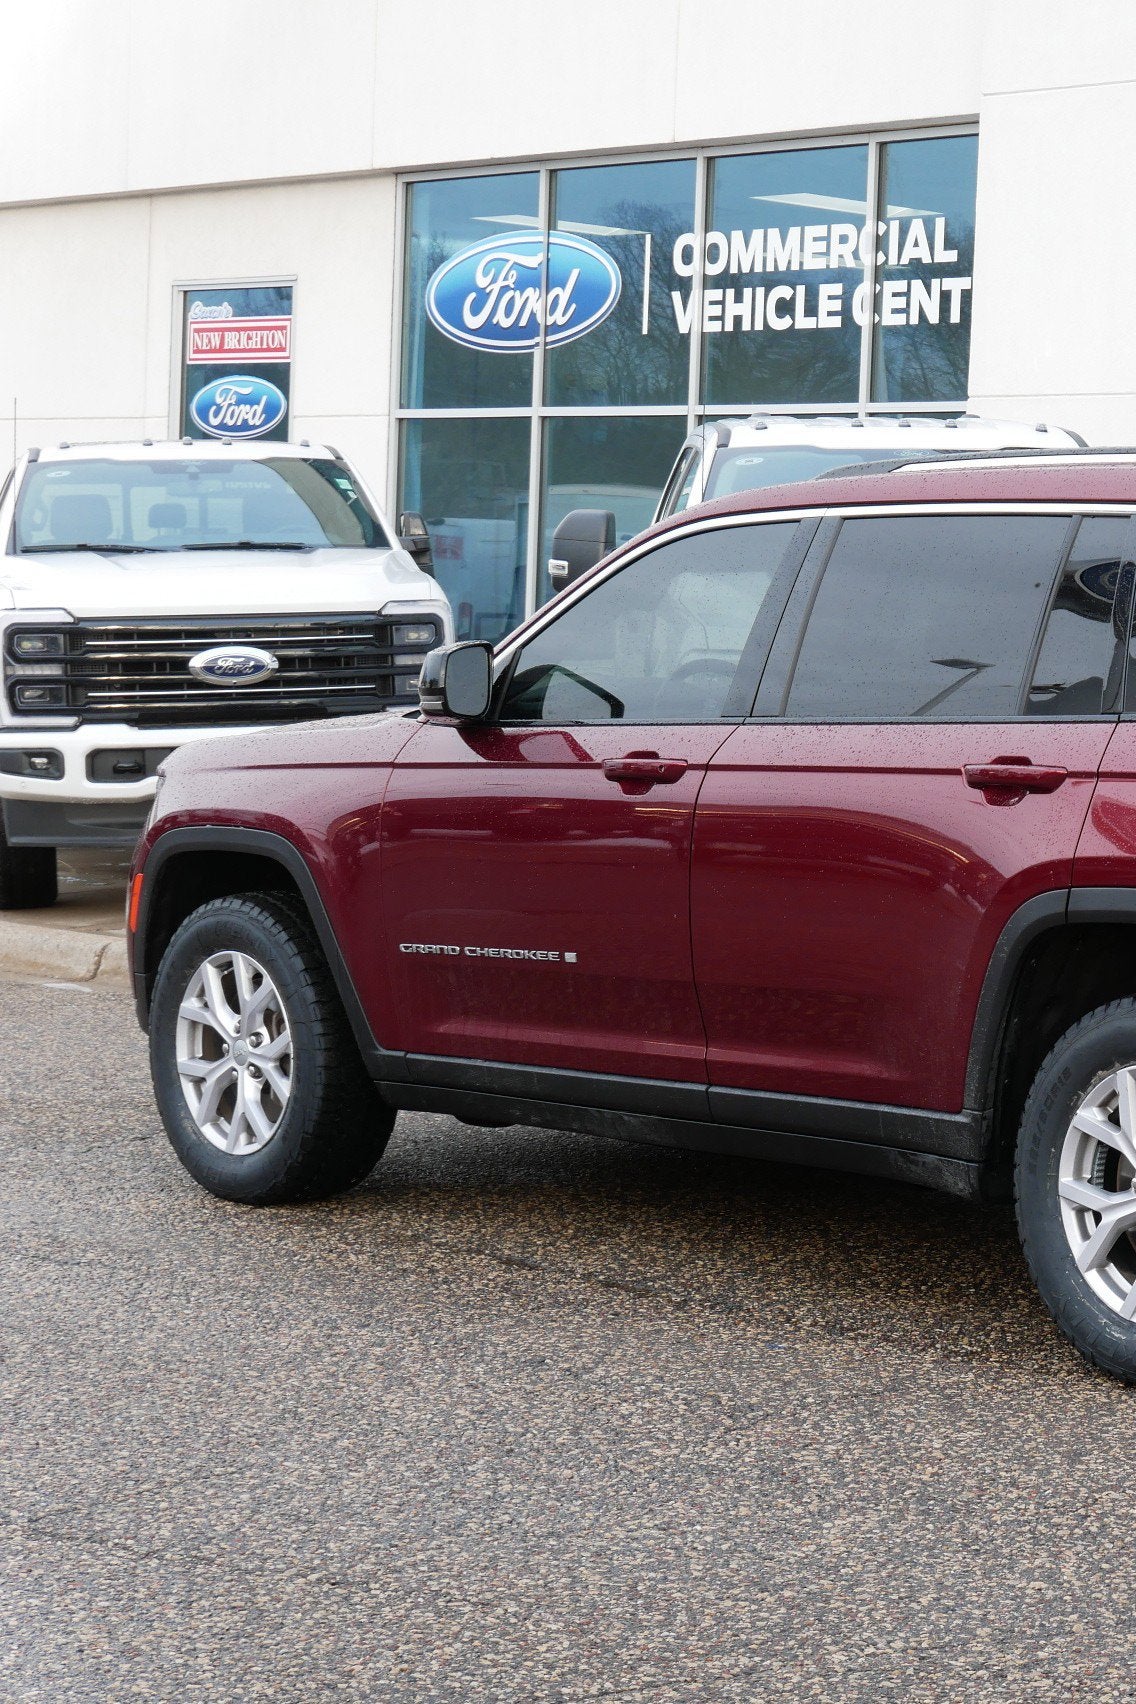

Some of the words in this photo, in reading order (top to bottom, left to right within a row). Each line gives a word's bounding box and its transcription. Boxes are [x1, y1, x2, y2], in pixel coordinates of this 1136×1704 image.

[672, 217, 958, 277] COMMERCIAL
[463, 252, 581, 330] Ford
[671, 283, 843, 334] VEHICLE
[193, 331, 221, 350] NEW
[224, 329, 287, 349] BRIGHTON
[208, 385, 268, 426] Ford
[214, 658, 256, 674] Ford
[400, 943, 460, 956] GRAND
[464, 946, 560, 961] CHEROKEE
